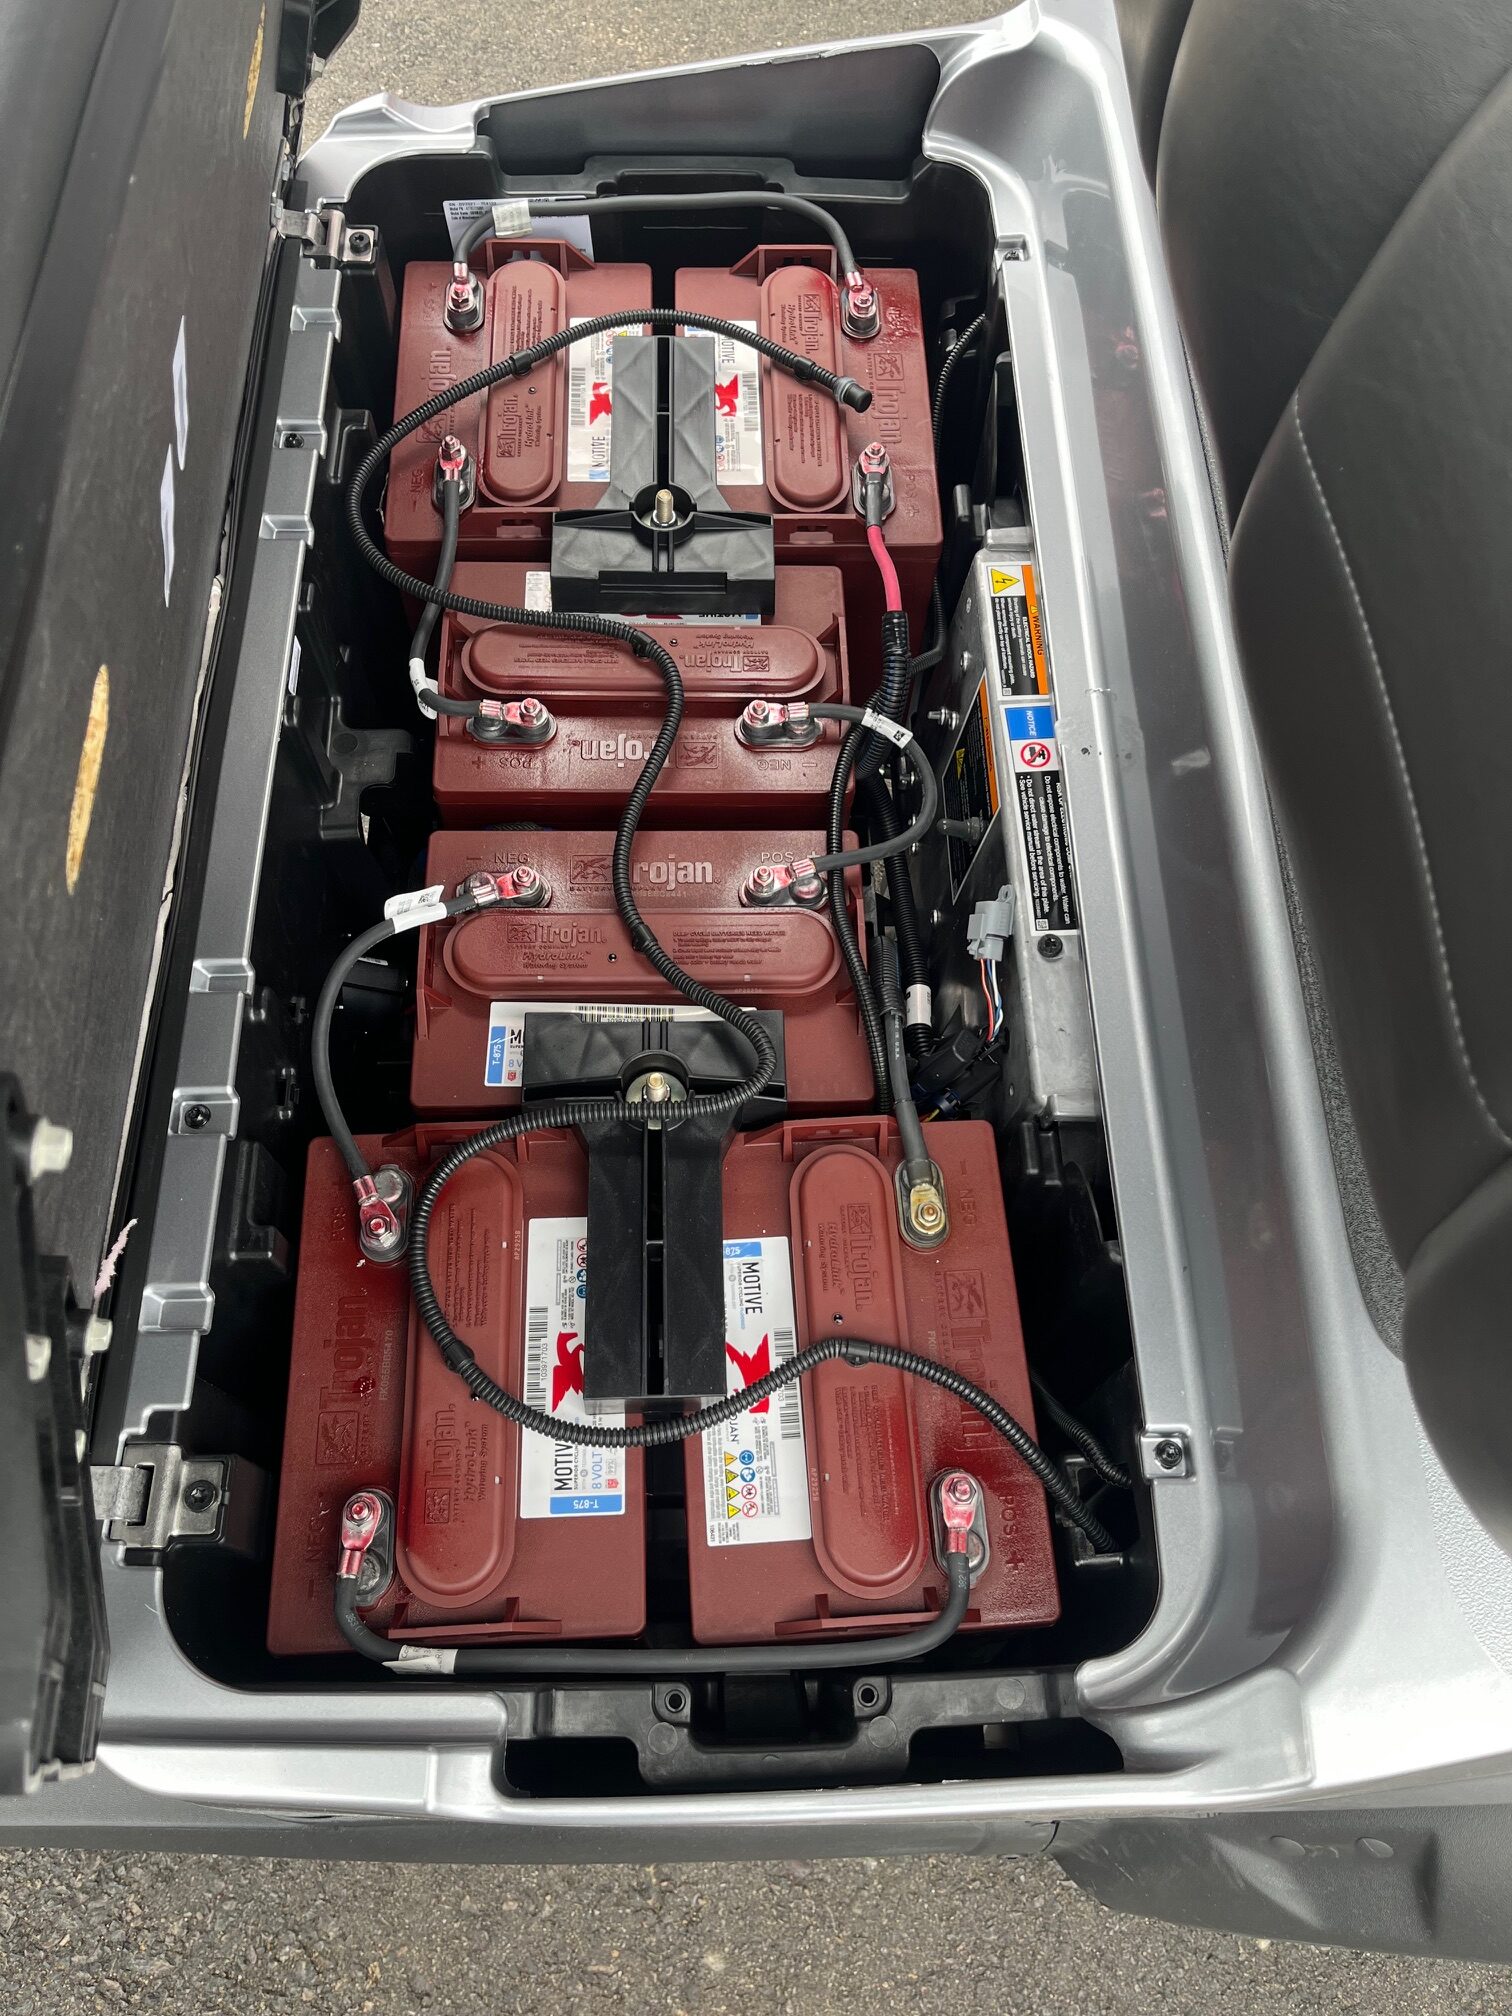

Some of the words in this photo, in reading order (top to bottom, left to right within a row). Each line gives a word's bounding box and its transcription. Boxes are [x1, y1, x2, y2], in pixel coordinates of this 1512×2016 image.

[591, 436, 606, 468] MOTIVE
[1004, 634, 1012, 655] component
[1022, 617, 1031, 643] ELECTRICAL
[1028, 660, 1036, 679] HAZARD
[1033, 615, 1044, 656] WARNING
[684, 651, 742, 673] Trojan
[1026, 710, 1037, 737] NOTICE
[499, 757, 533, 768] POS
[757, 759, 792, 770] NEG
[1044, 776, 1051, 784] Do
[1021, 791, 1030, 810] vehicle
[1047, 794, 1055, 813] expose
[1024, 811, 1032, 830] service
[1041, 814, 1050, 835] damage
[1050, 814, 1059, 838] electrical
[1026, 831, 1035, 852] manual
[1026, 779, 1032, 787] Do
[1033, 830, 1041, 849] stream
[1041, 898, 1049, 914] plate.
[1046, 843, 1055, 866] electrical
[1053, 838, 1064, 871] components
[494, 852, 530, 864] NEG
[761, 852, 794, 863] POS
[1029, 852, 1037, 870] before
[633, 854, 713, 891] rojan
[1049, 867, 1058, 902] components.
[537, 922, 603, 947] Trojan
[522, 952, 584, 962] HydroLink
[491, 1042, 503, 1065] T-875
[959, 1188, 978, 1226] NEG
[847, 1235, 878, 1306] Trojan
[742, 1262, 763, 1315] MOTIVE
[319, 1296, 376, 1410] Trojan
[424, 1410, 461, 1487] Trojan
[479, 1424, 488, 1457] System
[463, 1428, 477, 1502] HydroLink
[554, 1443, 574, 1490] MOTIV
[592, 1452, 602, 1480] VOLT
[478, 1461, 488, 1501] Watering
[573, 1499, 599, 1509] T-875
[998, 1495, 1017, 1537] POS
